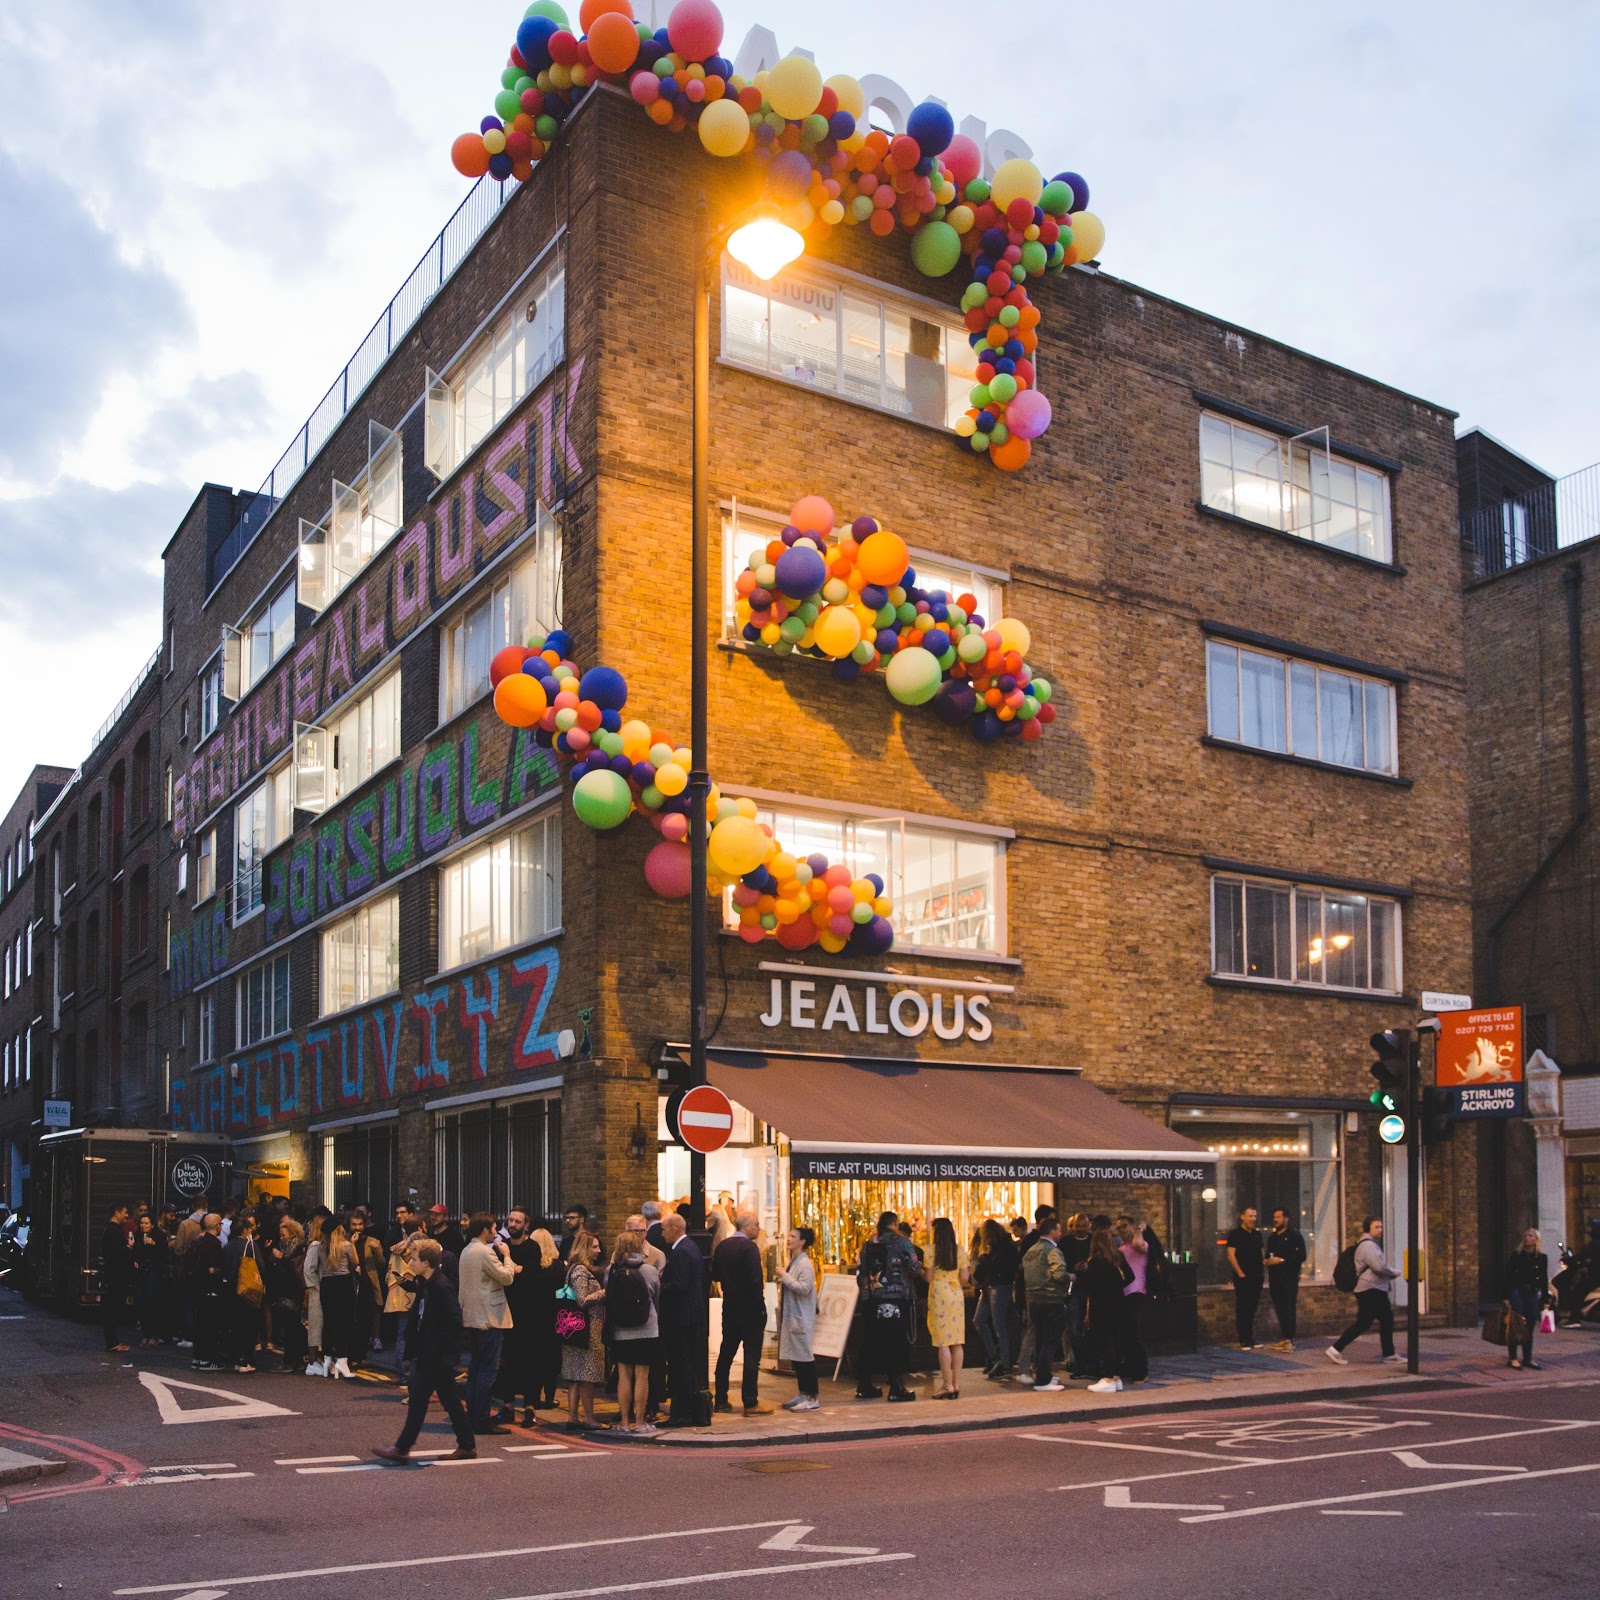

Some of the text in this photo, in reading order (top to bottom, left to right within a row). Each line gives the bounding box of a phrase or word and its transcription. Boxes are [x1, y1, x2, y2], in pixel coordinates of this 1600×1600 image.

[1425, 997, 1469, 1008] CURTAIN ROAD
[759, 978, 993, 1042] JEALOUS
[1468, 1012, 1515, 1024] OFFICE TO LET
[1455, 1023, 1515, 1035] 0207 729 7763
[1461, 1088, 1515, 1101] STIRLING
[1461, 1099, 1515, 1111] ACKROYD
[177, 1168, 205, 1181] Dough
[809, 1161, 1204, 1180] FINE ART PUBLISHING SILKSCREEN & DIGITAL PRINT STUDIO GALLERY SPACE
[179, 1177, 205, 1189] Shack
